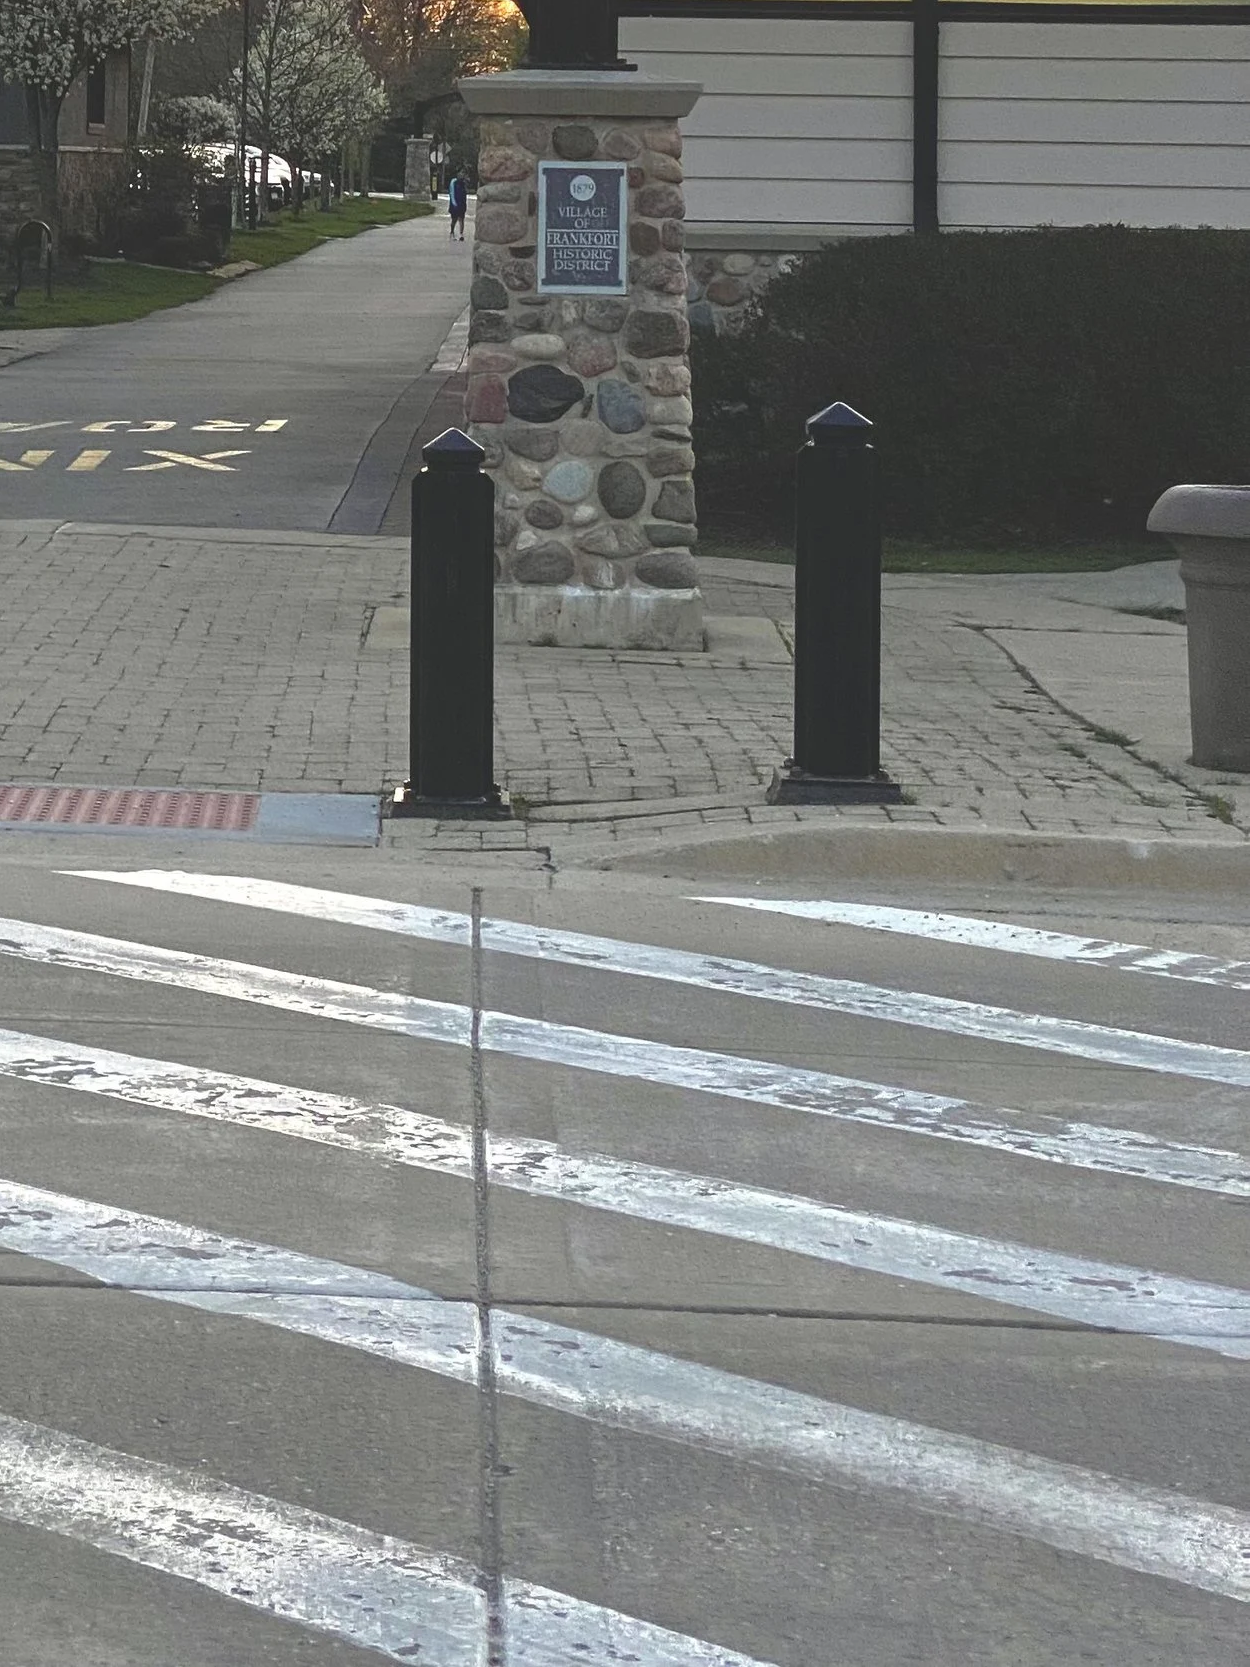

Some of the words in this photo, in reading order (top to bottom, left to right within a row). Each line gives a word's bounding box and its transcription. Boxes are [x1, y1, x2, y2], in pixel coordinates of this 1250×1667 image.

[558, 206, 607, 217] VILLAGE
[574, 218, 590, 228] OF
[547, 233, 618, 245] FRANKFORT
[553, 248, 612, 260] HISTORIC
[554, 260, 611, 271] DISTRICT
